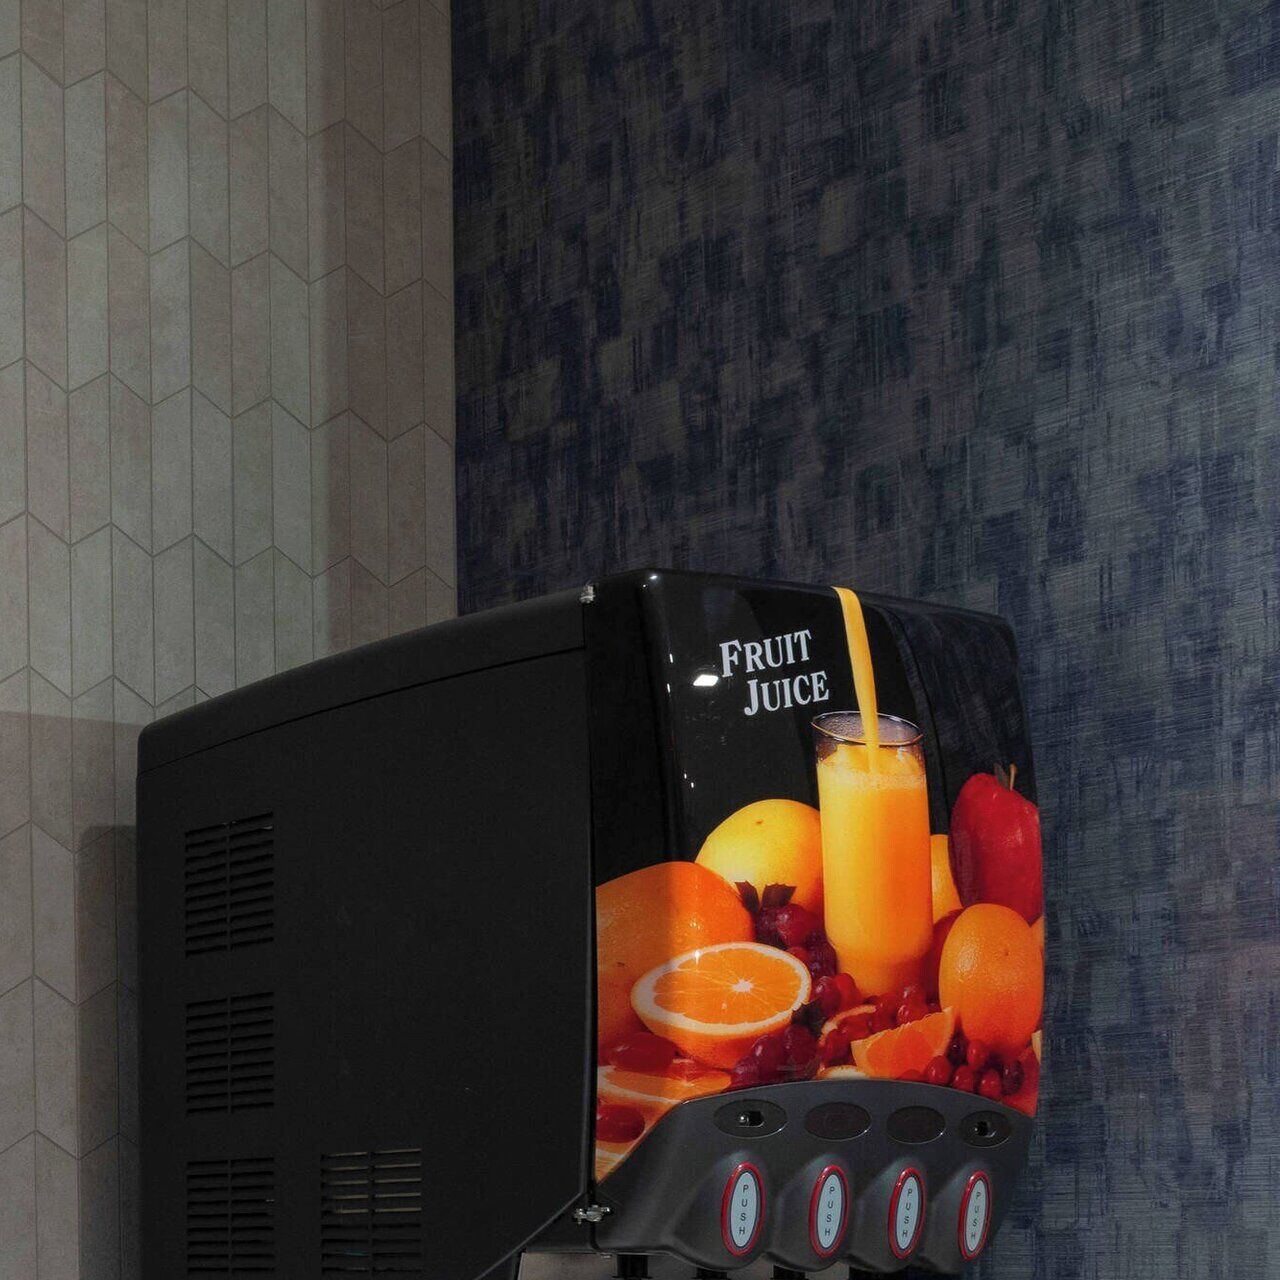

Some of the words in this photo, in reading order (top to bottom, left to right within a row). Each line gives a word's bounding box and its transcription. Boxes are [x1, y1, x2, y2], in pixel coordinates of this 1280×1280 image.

[719, 629, 812, 678] FRUIT
[744, 670, 830, 716] JUICE
[738, 1184, 749, 1235] PUSH
[824, 1186, 836, 1237] PUSH
[901, 1188, 913, 1238] PUSH
[970, 1191, 982, 1241] PUSH
